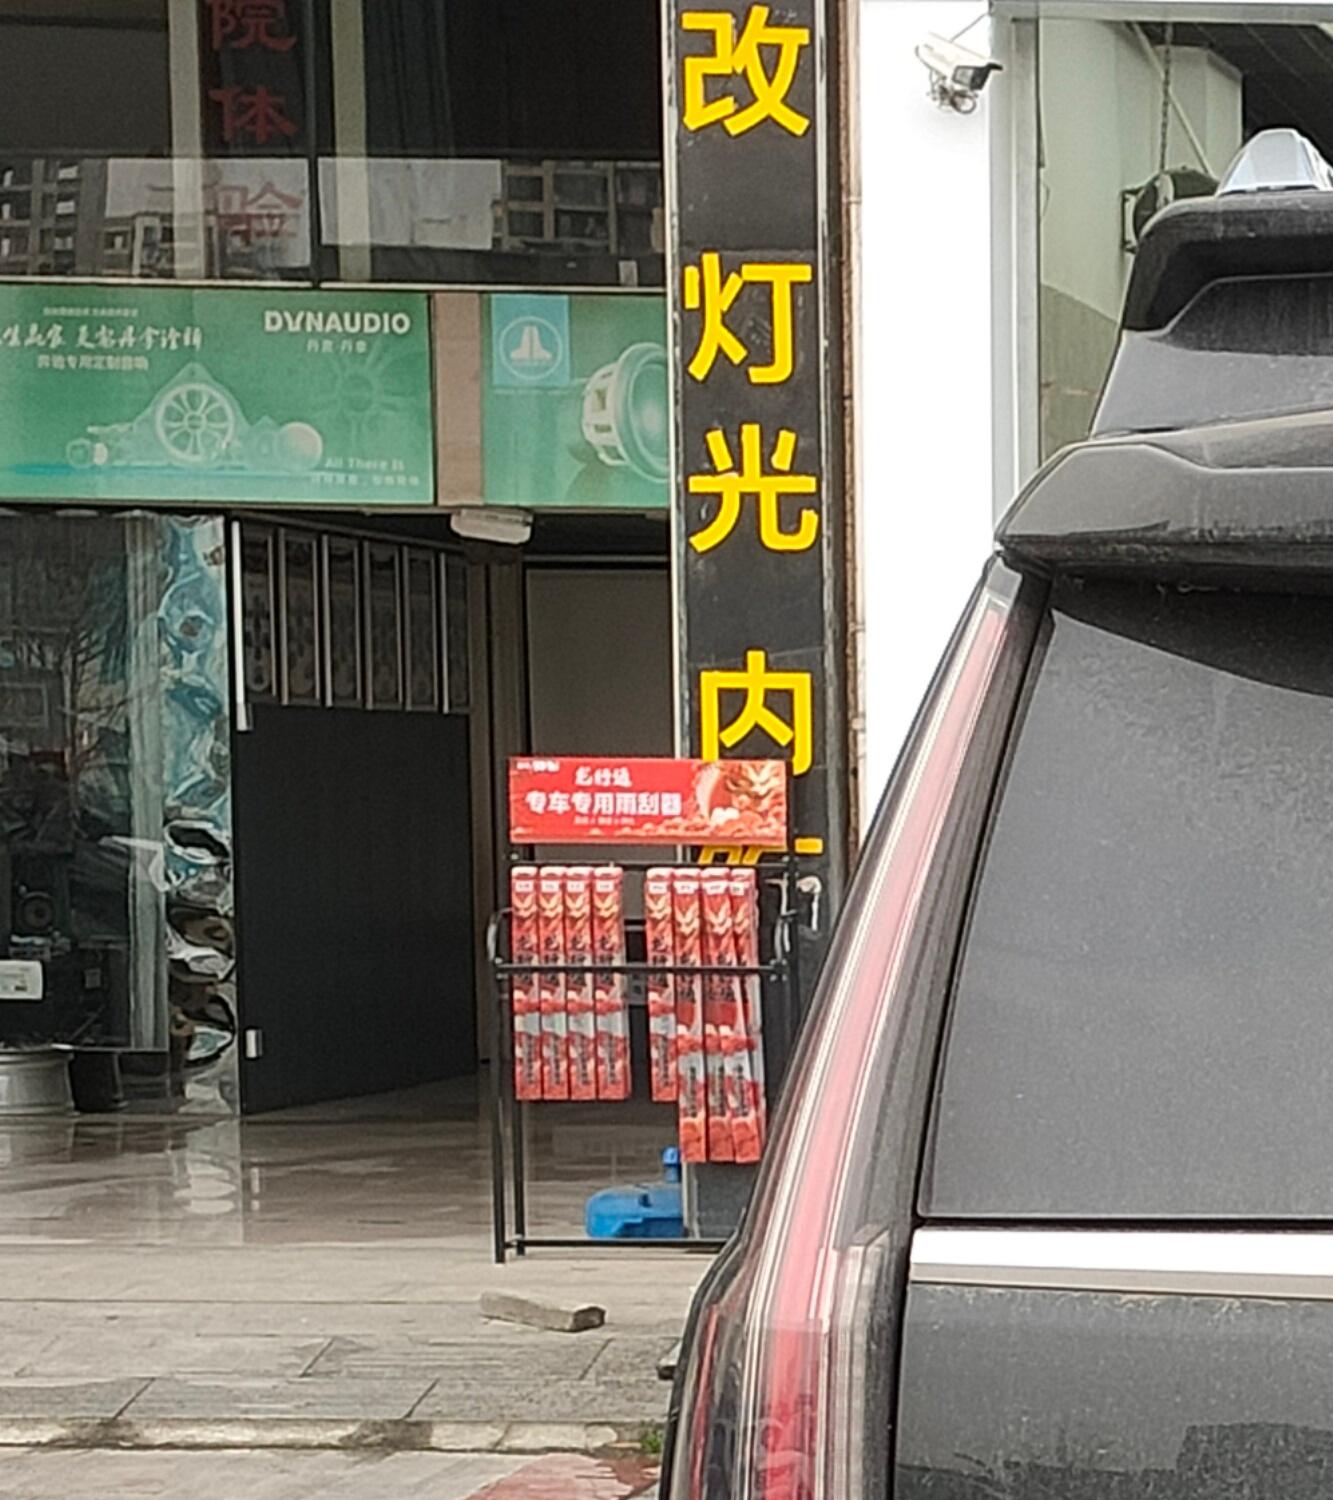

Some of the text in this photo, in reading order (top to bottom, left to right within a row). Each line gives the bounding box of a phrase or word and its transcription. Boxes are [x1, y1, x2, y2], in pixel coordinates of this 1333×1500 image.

[681, 4, 810, 136] 改
[264, 310, 412, 335] DYNAUDIO
[684, 252, 820, 552] 灯光
[525, 791, 682, 816] 专车专用雨刮器
